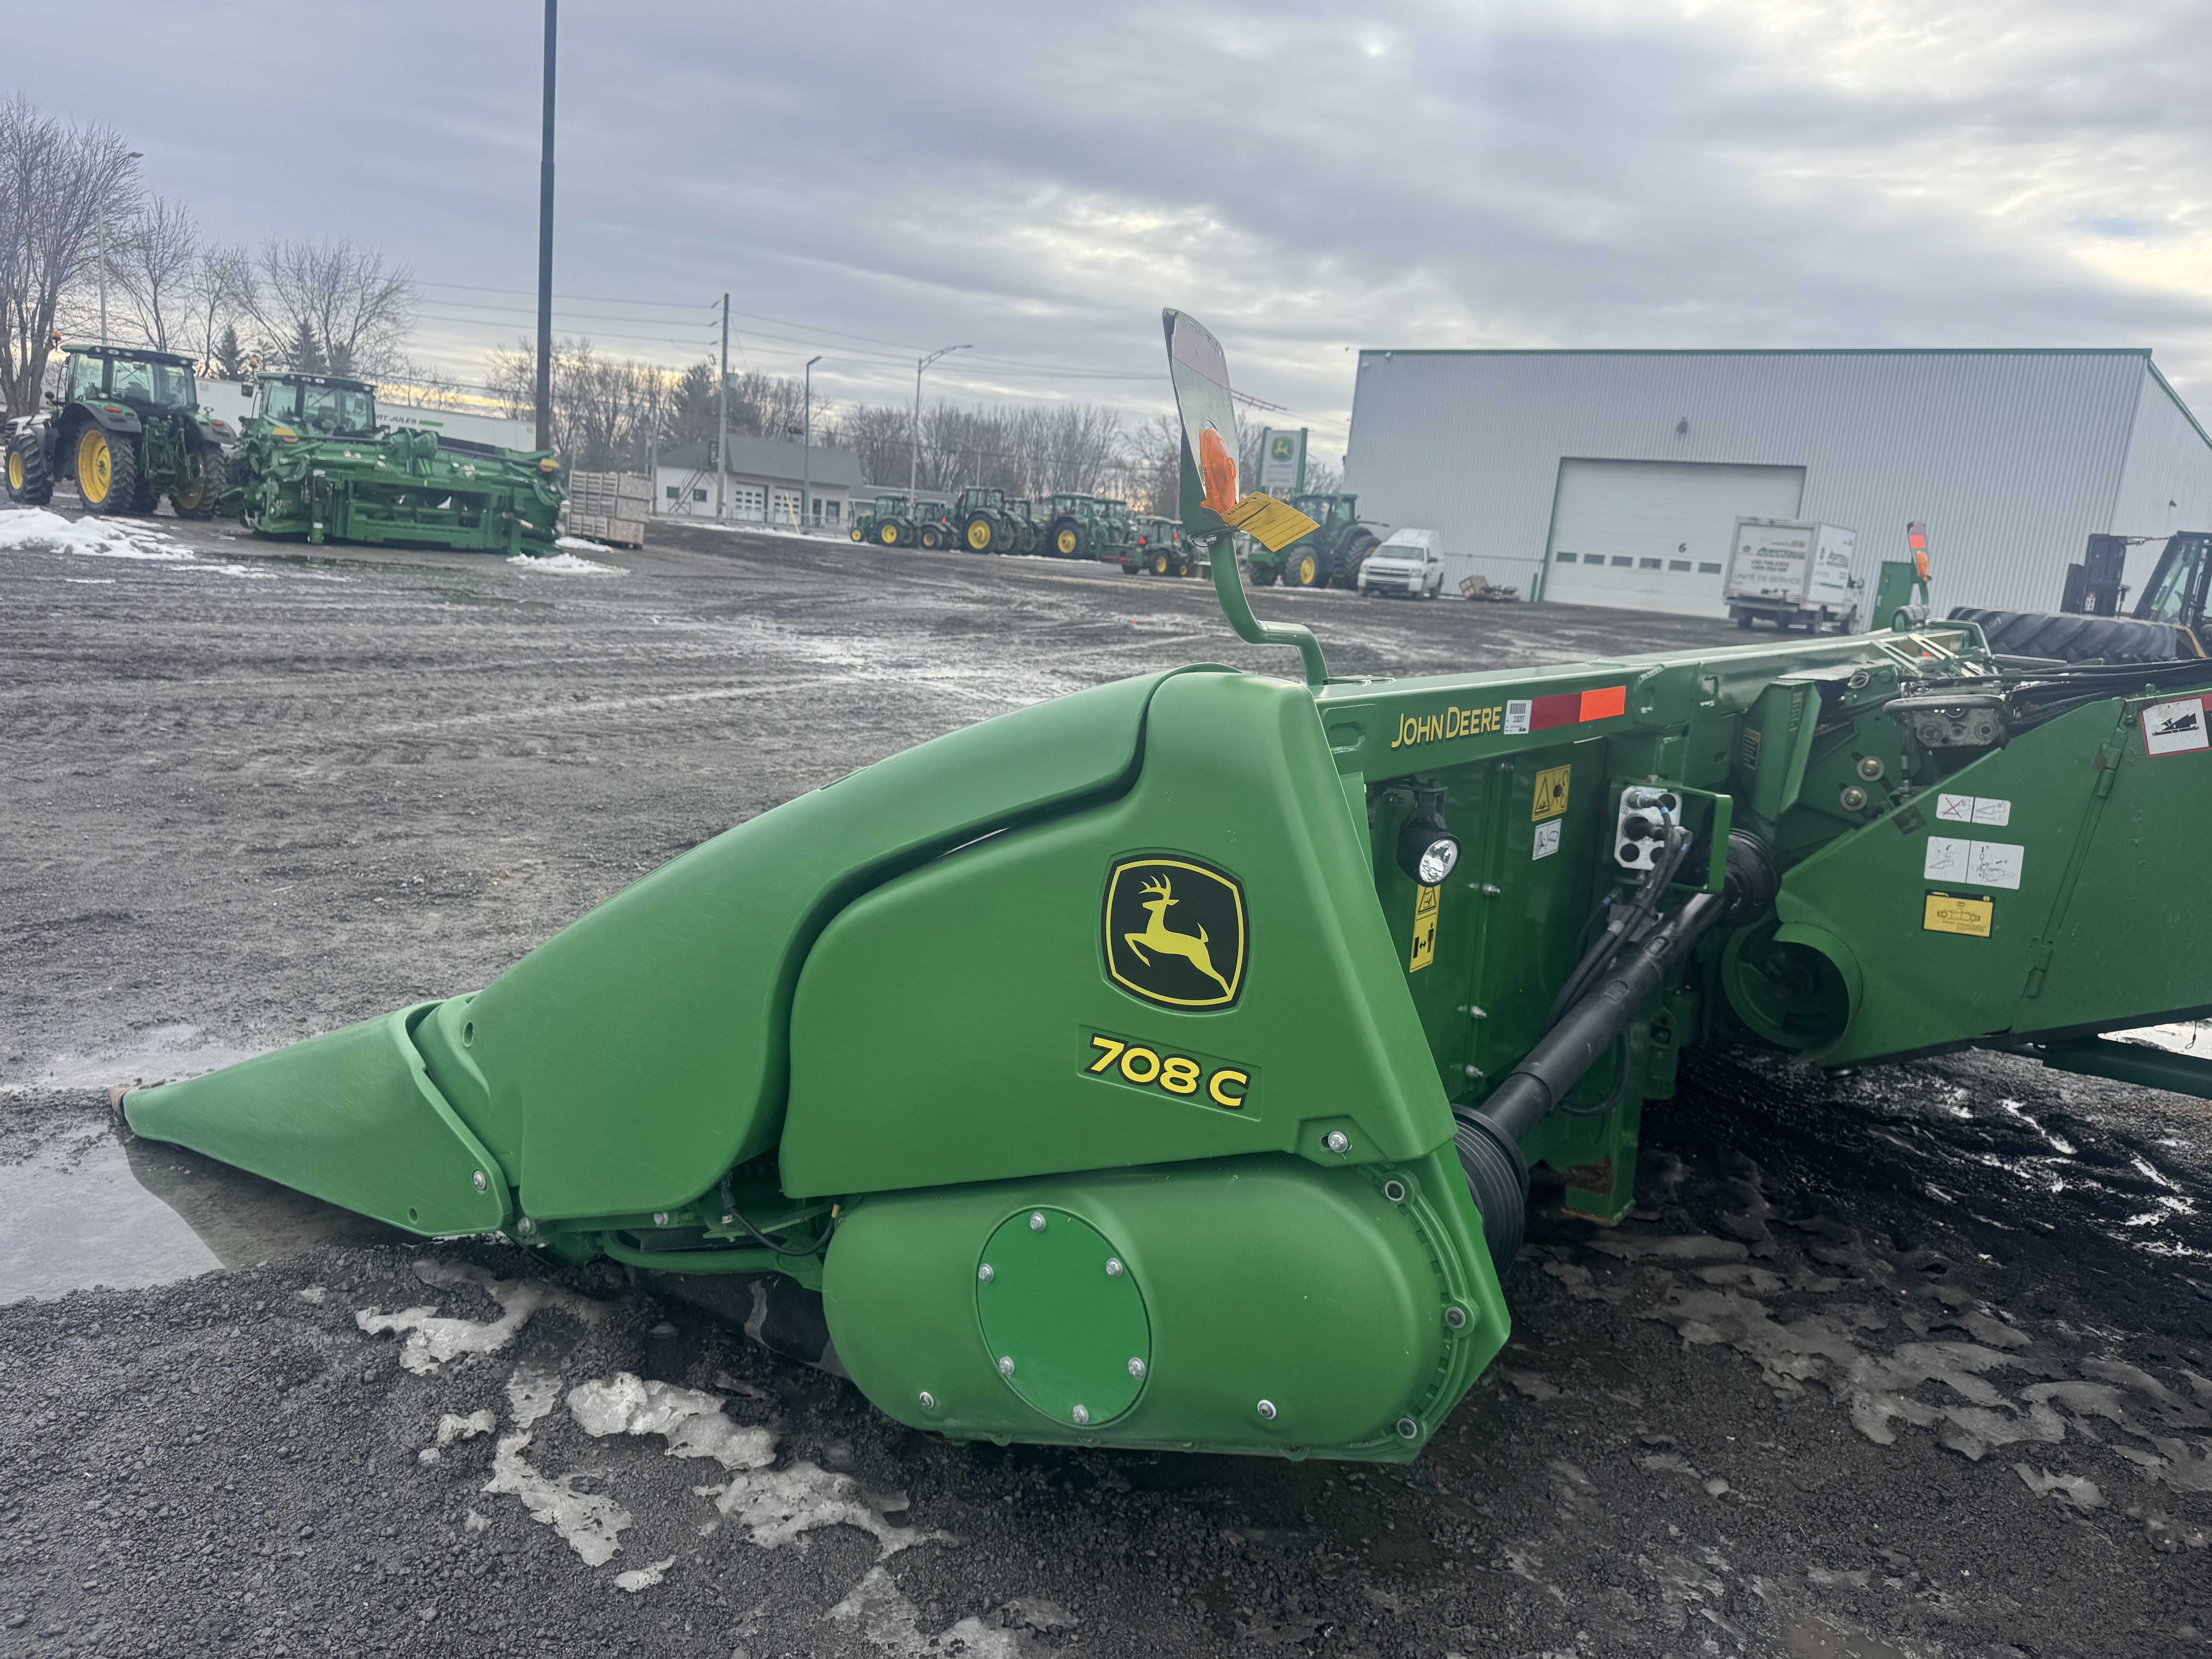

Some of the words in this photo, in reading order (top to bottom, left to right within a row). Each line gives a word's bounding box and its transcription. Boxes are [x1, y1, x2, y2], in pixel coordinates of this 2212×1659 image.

[390, 416, 417, 424] JULES
[1678, 542, 1686, 553] 6
[1757, 574, 1768, 582] DE
[1769, 574, 1802, 585] SERVICE
[1391, 713, 1444, 748] JOHN
[1446, 706, 1502, 738] DEERE
[1085, 1034, 1201, 1096] 708
[1207, 1068, 1250, 1109] C
